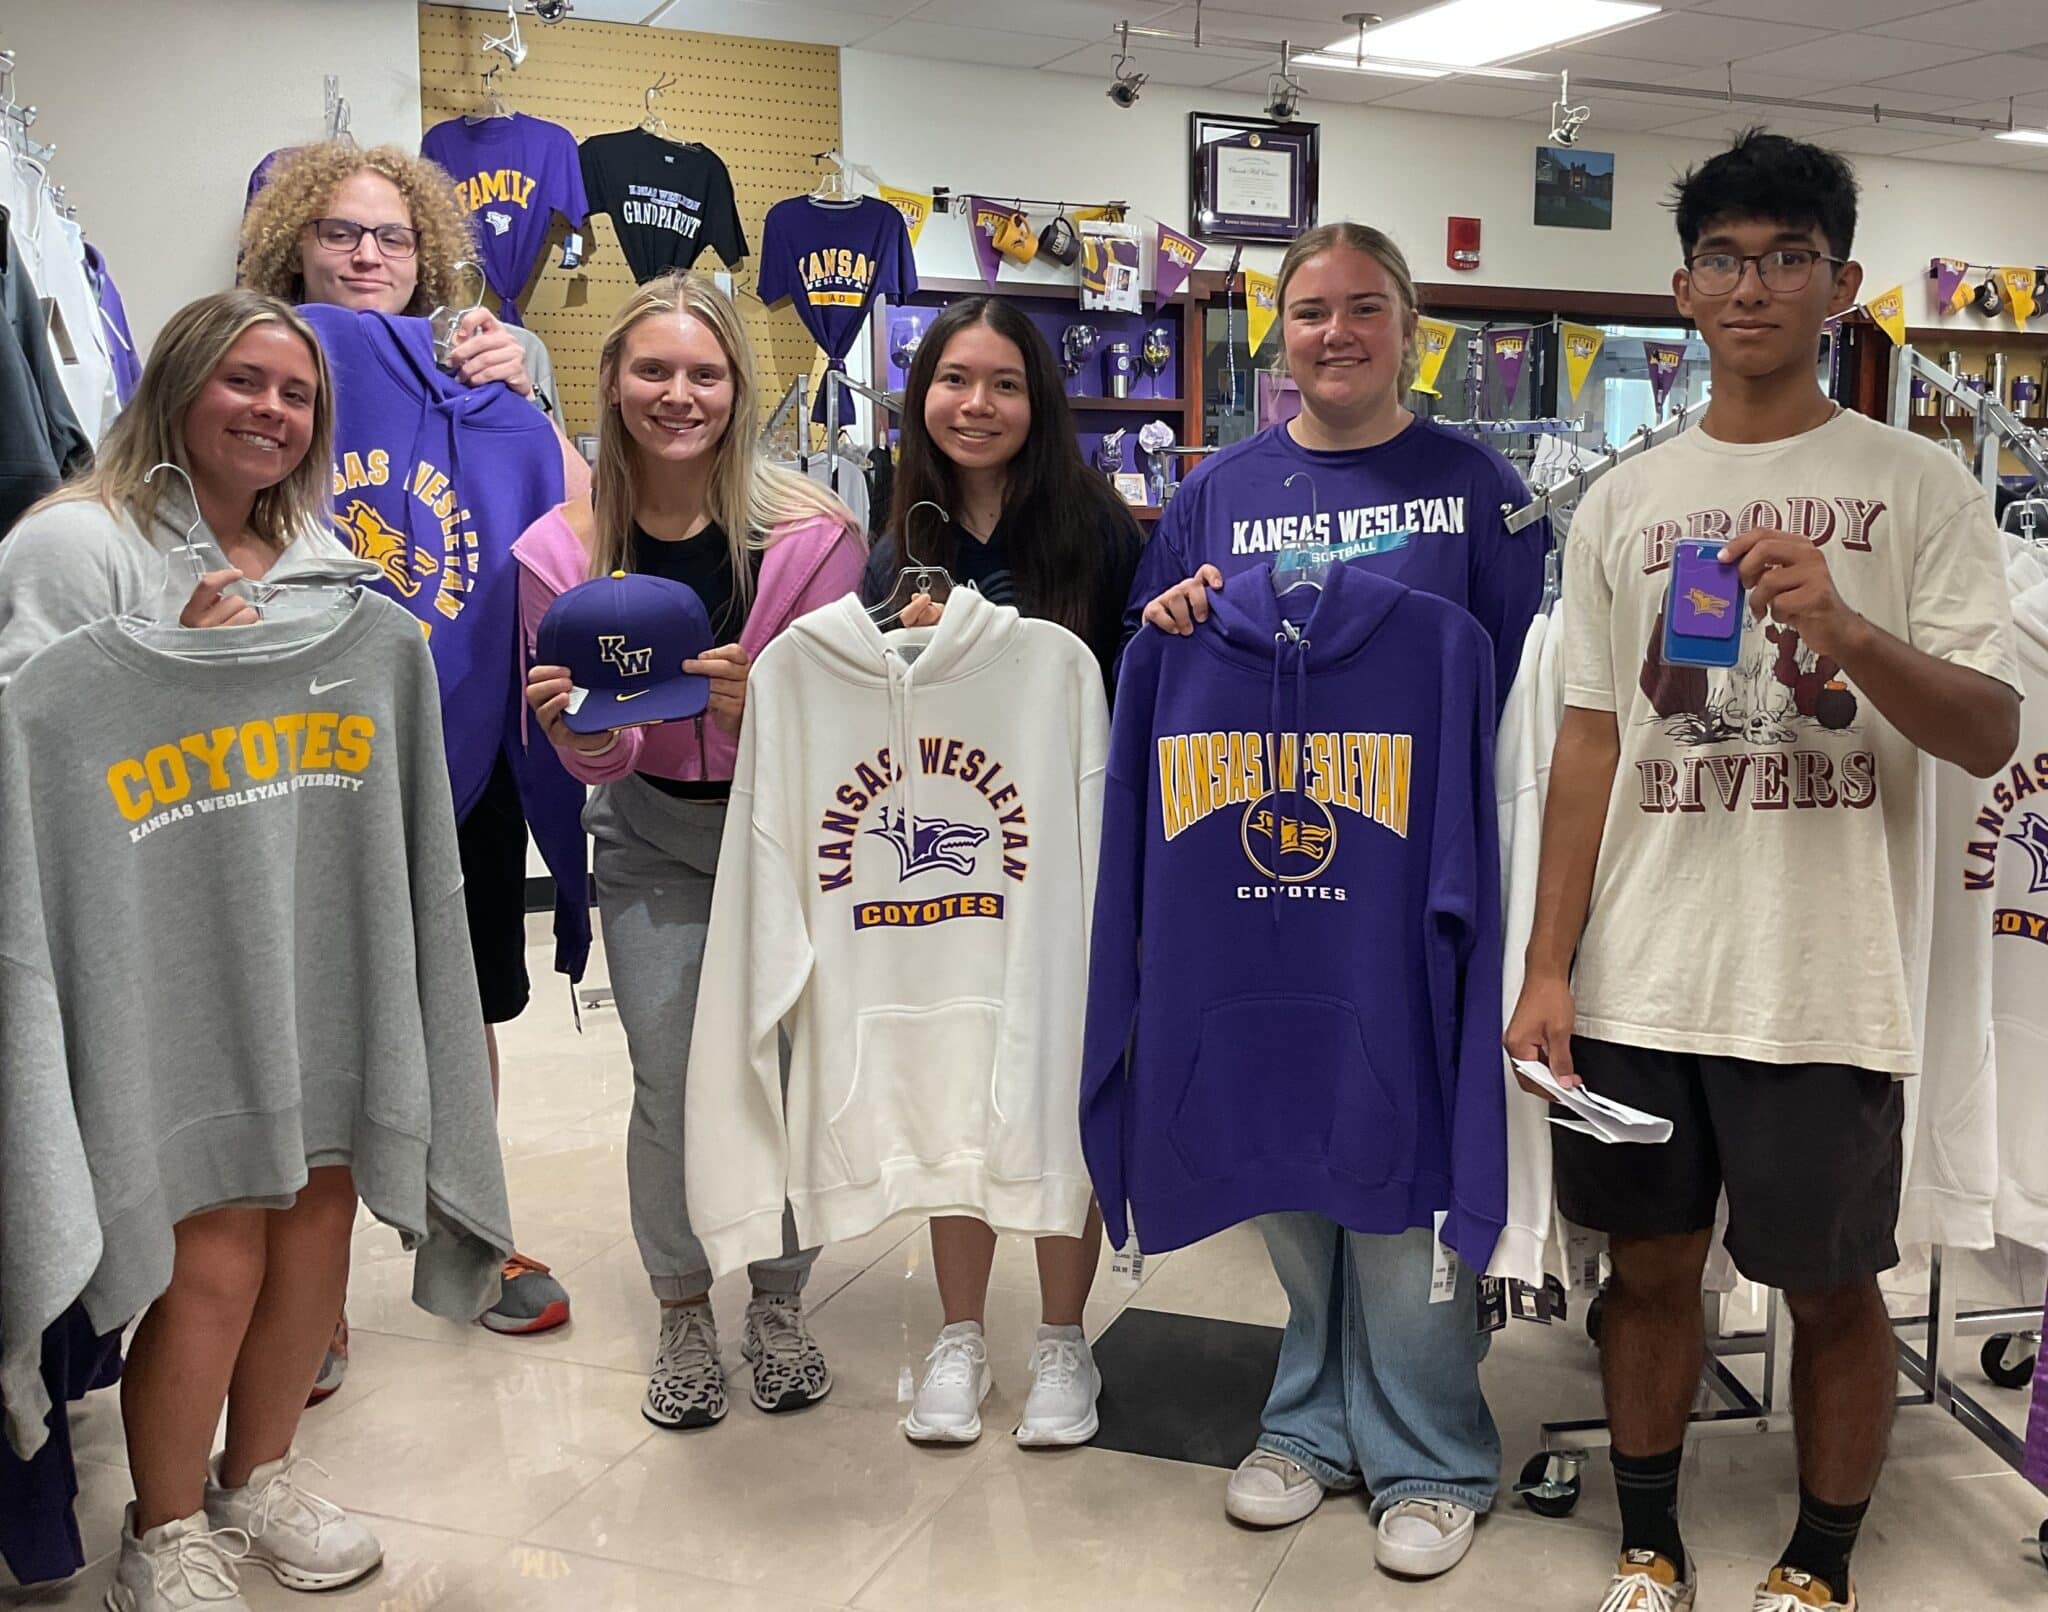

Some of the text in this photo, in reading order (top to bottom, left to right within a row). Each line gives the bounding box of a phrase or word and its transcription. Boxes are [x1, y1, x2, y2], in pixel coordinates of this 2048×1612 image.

[1231, 496, 1464, 555] KANSAS WESLEYAN
[1311, 541, 1377, 563] SOFTBALL
[1641, 496, 1888, 575] BRODY
[598, 635, 652, 677] KW
[106, 711, 377, 822] COYOTES
[1158, 731, 1264, 842] KANSAS
[1635, 751, 1877, 814] RIVERS
[128, 803, 195, 844] KANSAS
[196, 780, 289, 814] WESLEYAN
[817, 736, 1029, 893] KANSAS WESLEYAN
[860, 896, 999, 926] COYOTES
[1237, 885, 1347, 901] COYOTES
